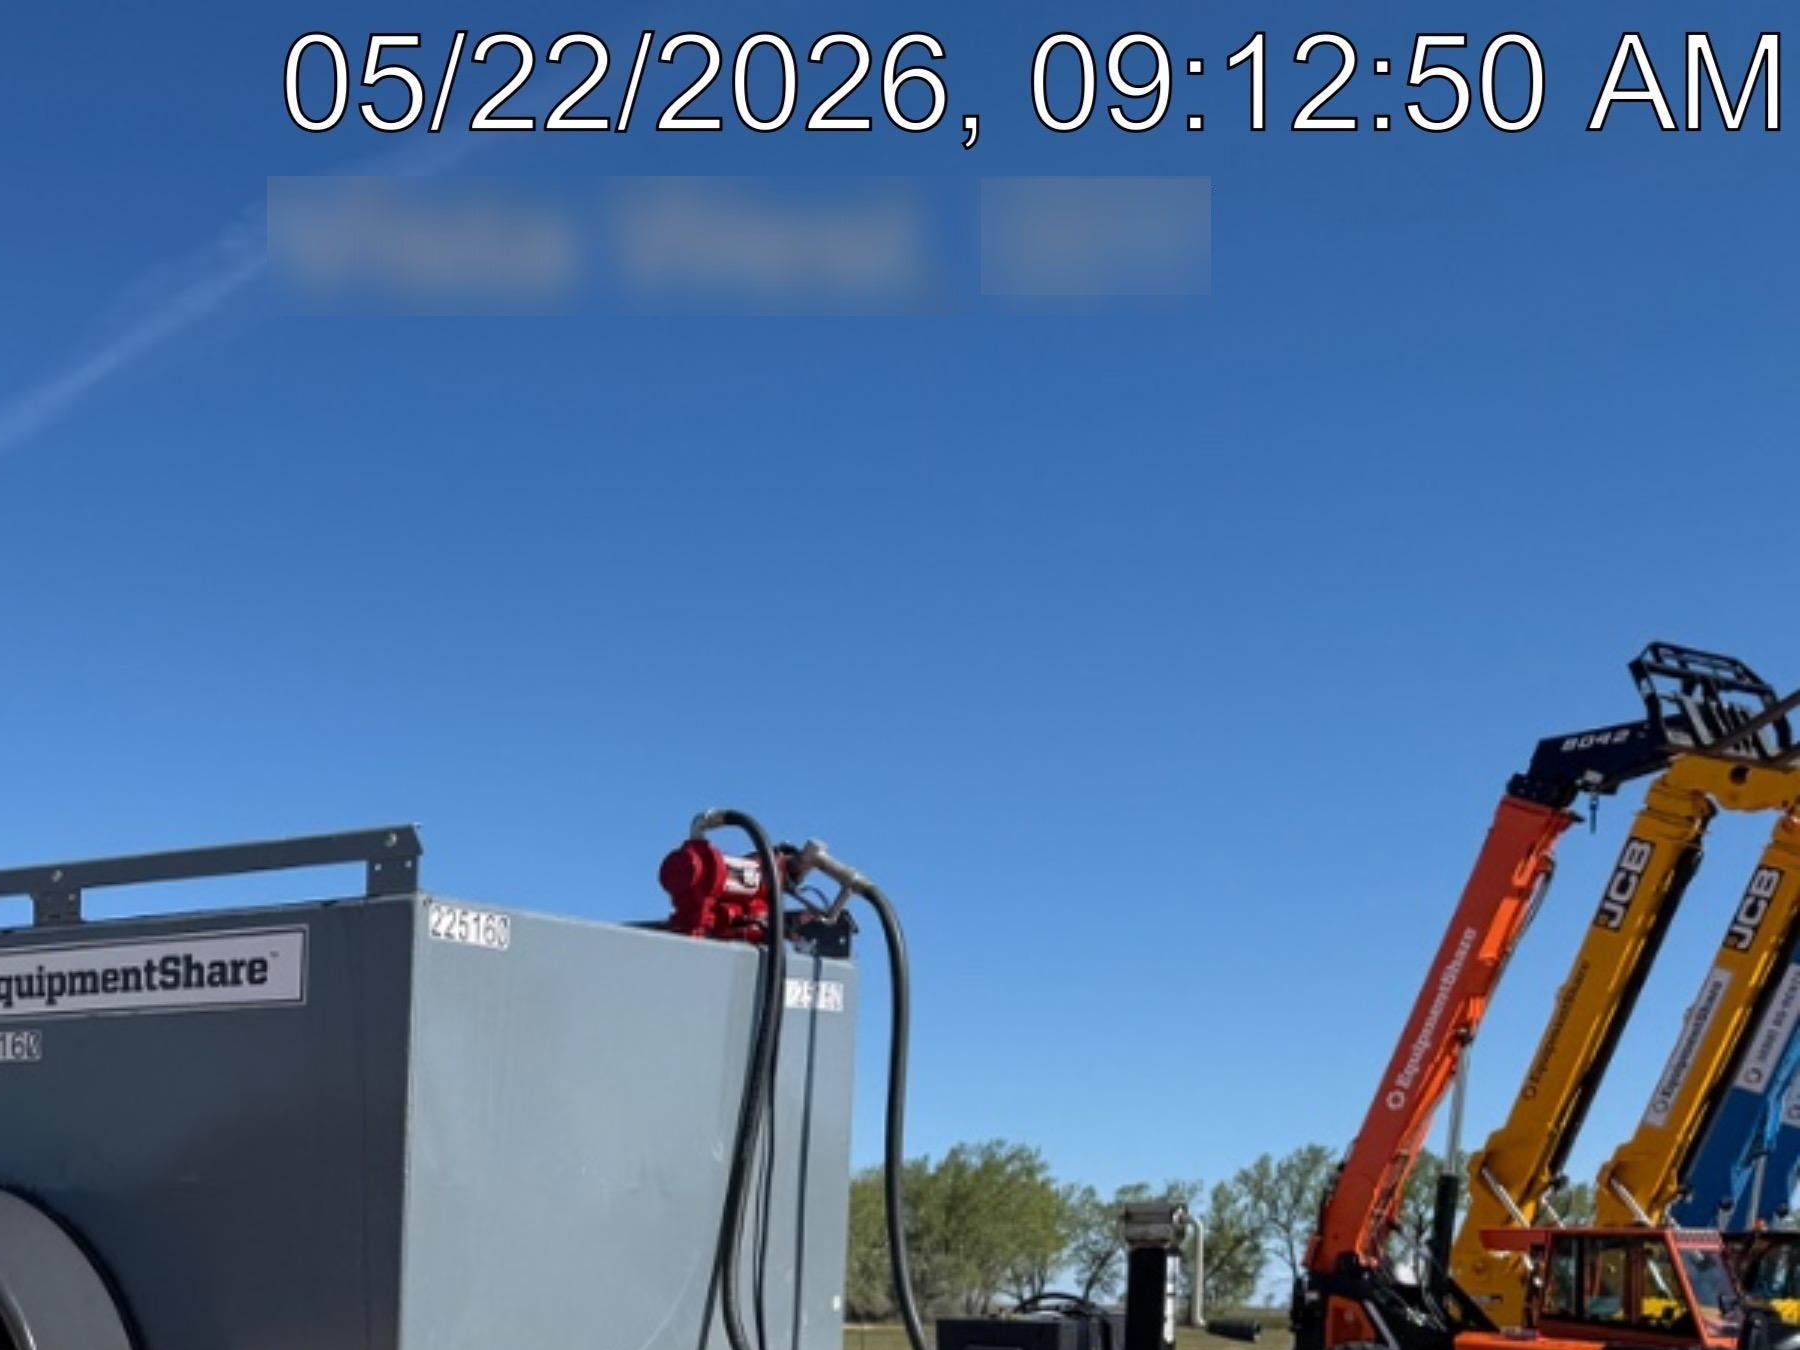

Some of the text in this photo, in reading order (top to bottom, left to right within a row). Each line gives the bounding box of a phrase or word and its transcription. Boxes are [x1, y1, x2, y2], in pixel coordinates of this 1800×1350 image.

[1602, 840, 1653, 931] JCB
[1728, 869, 1780, 950] JCB
[1397, 929, 1476, 1093] EquipmentShare
